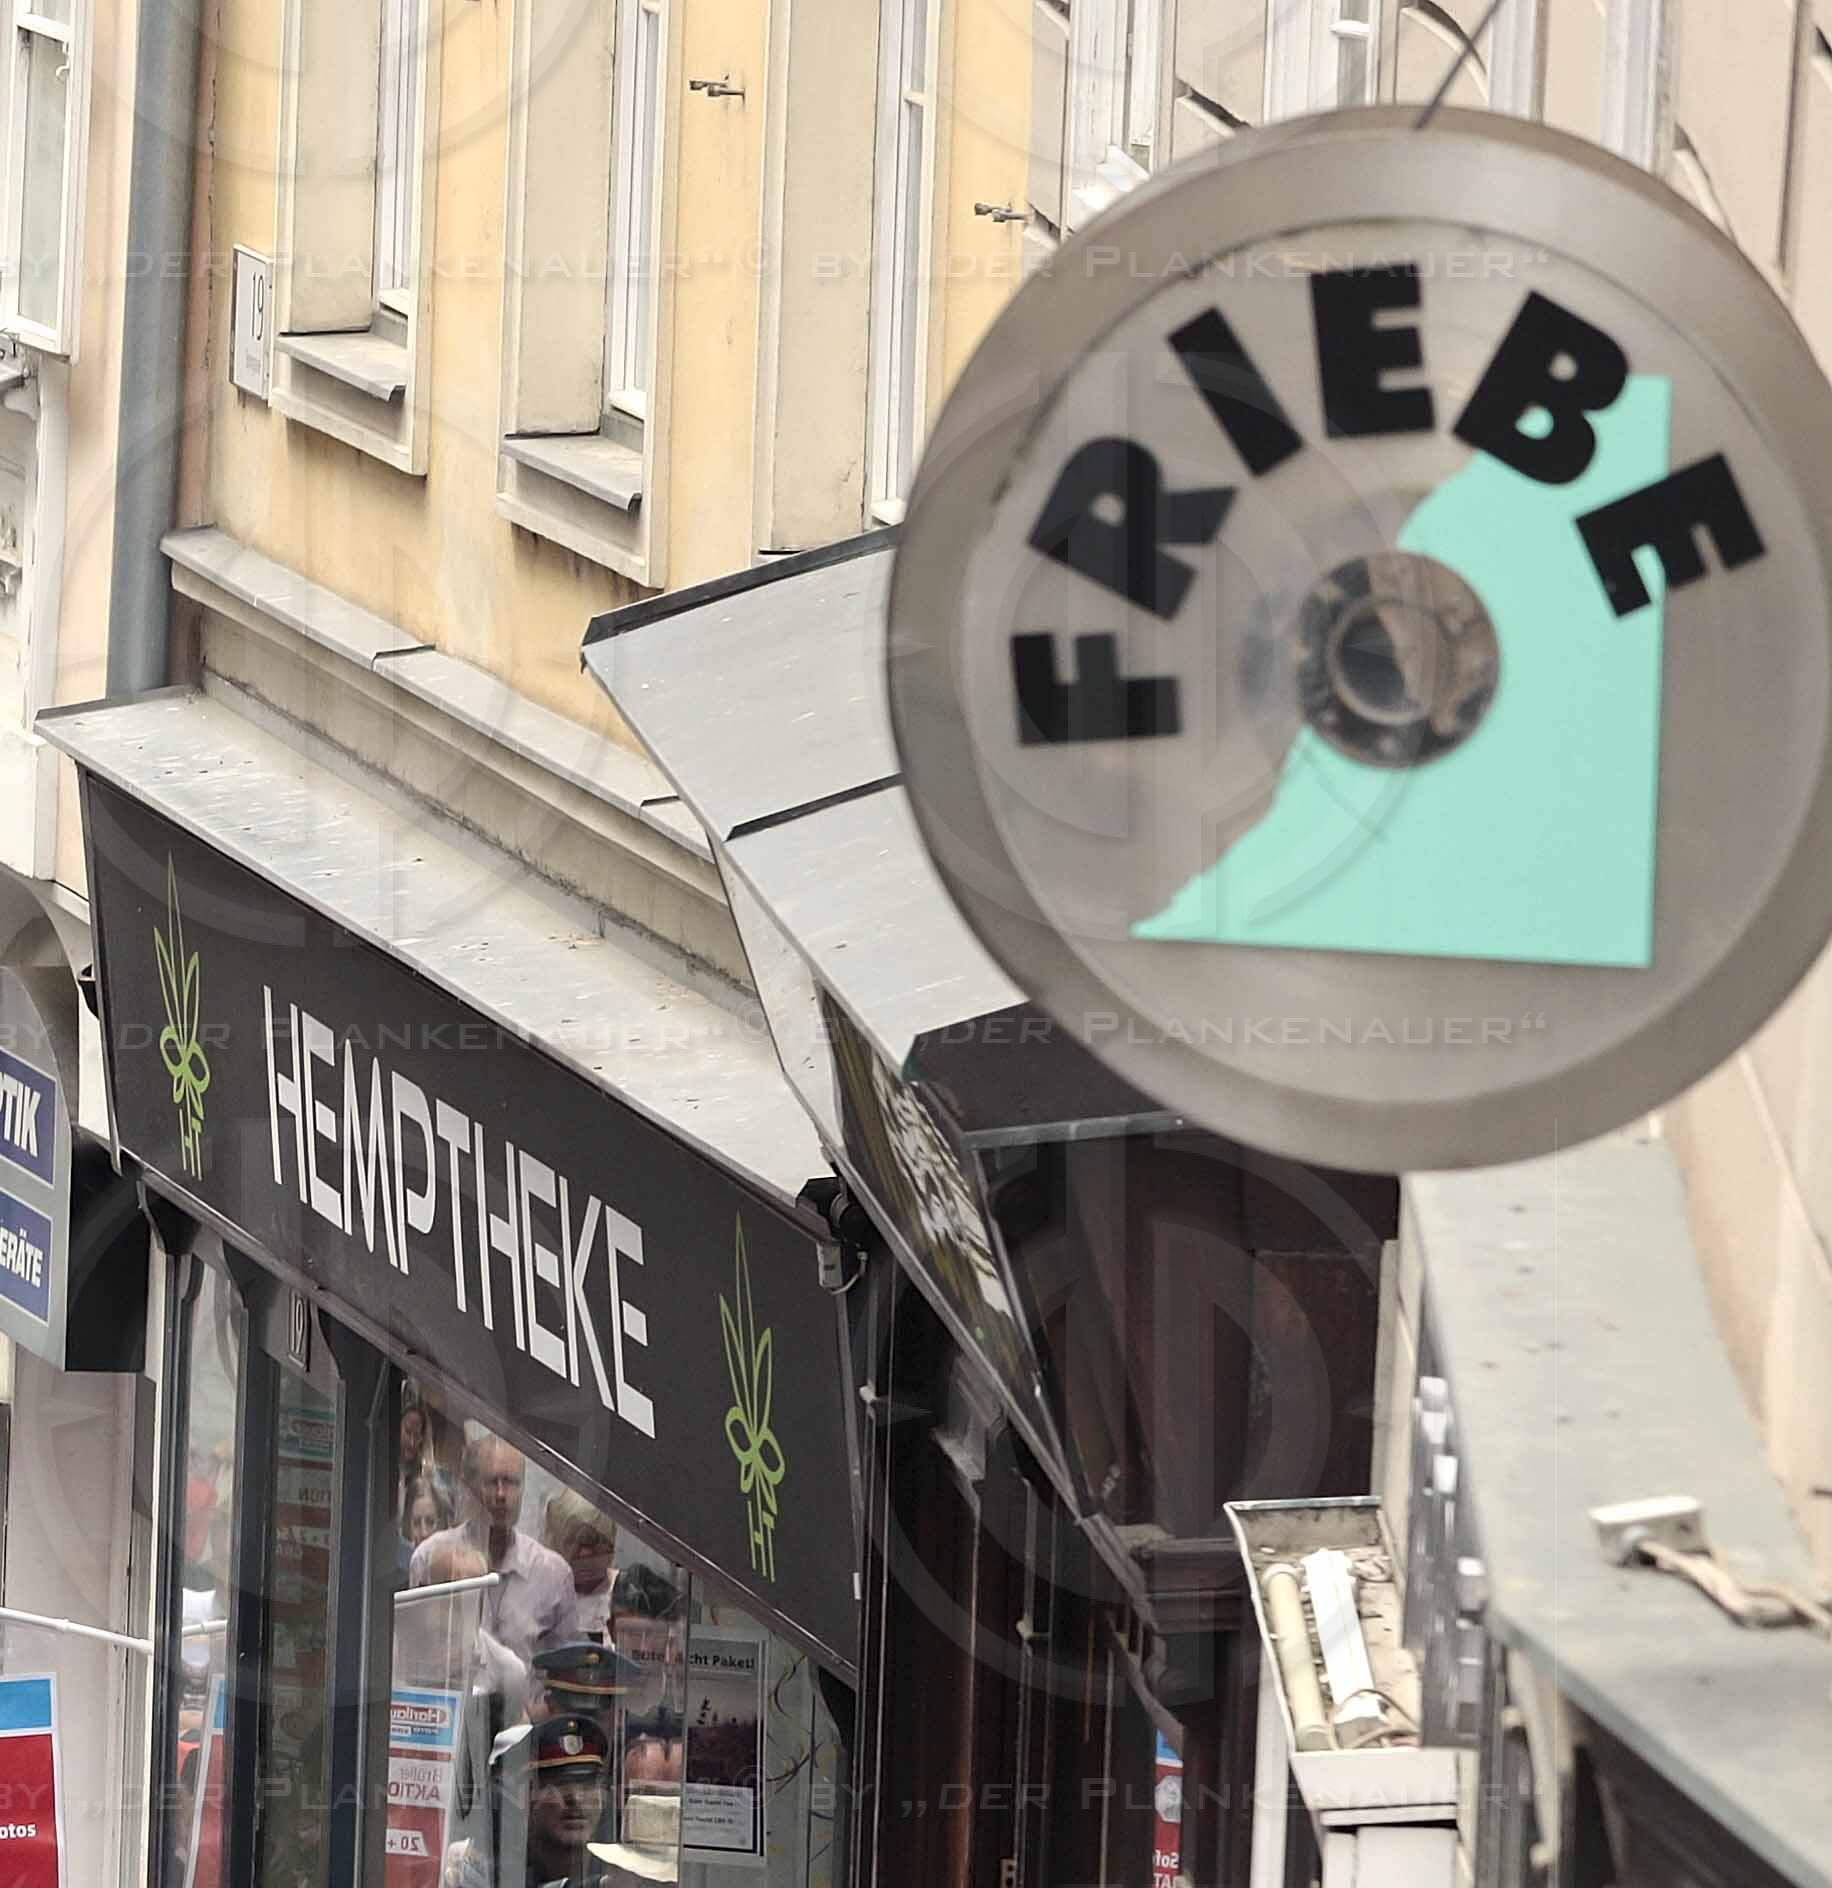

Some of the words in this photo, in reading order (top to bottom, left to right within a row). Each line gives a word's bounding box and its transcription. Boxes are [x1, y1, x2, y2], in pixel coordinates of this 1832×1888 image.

[251, 271, 265, 342] 19
[1011, 263, 1767, 749] FRIEBE
[262, 985, 656, 1441] HEMPTHEKE
